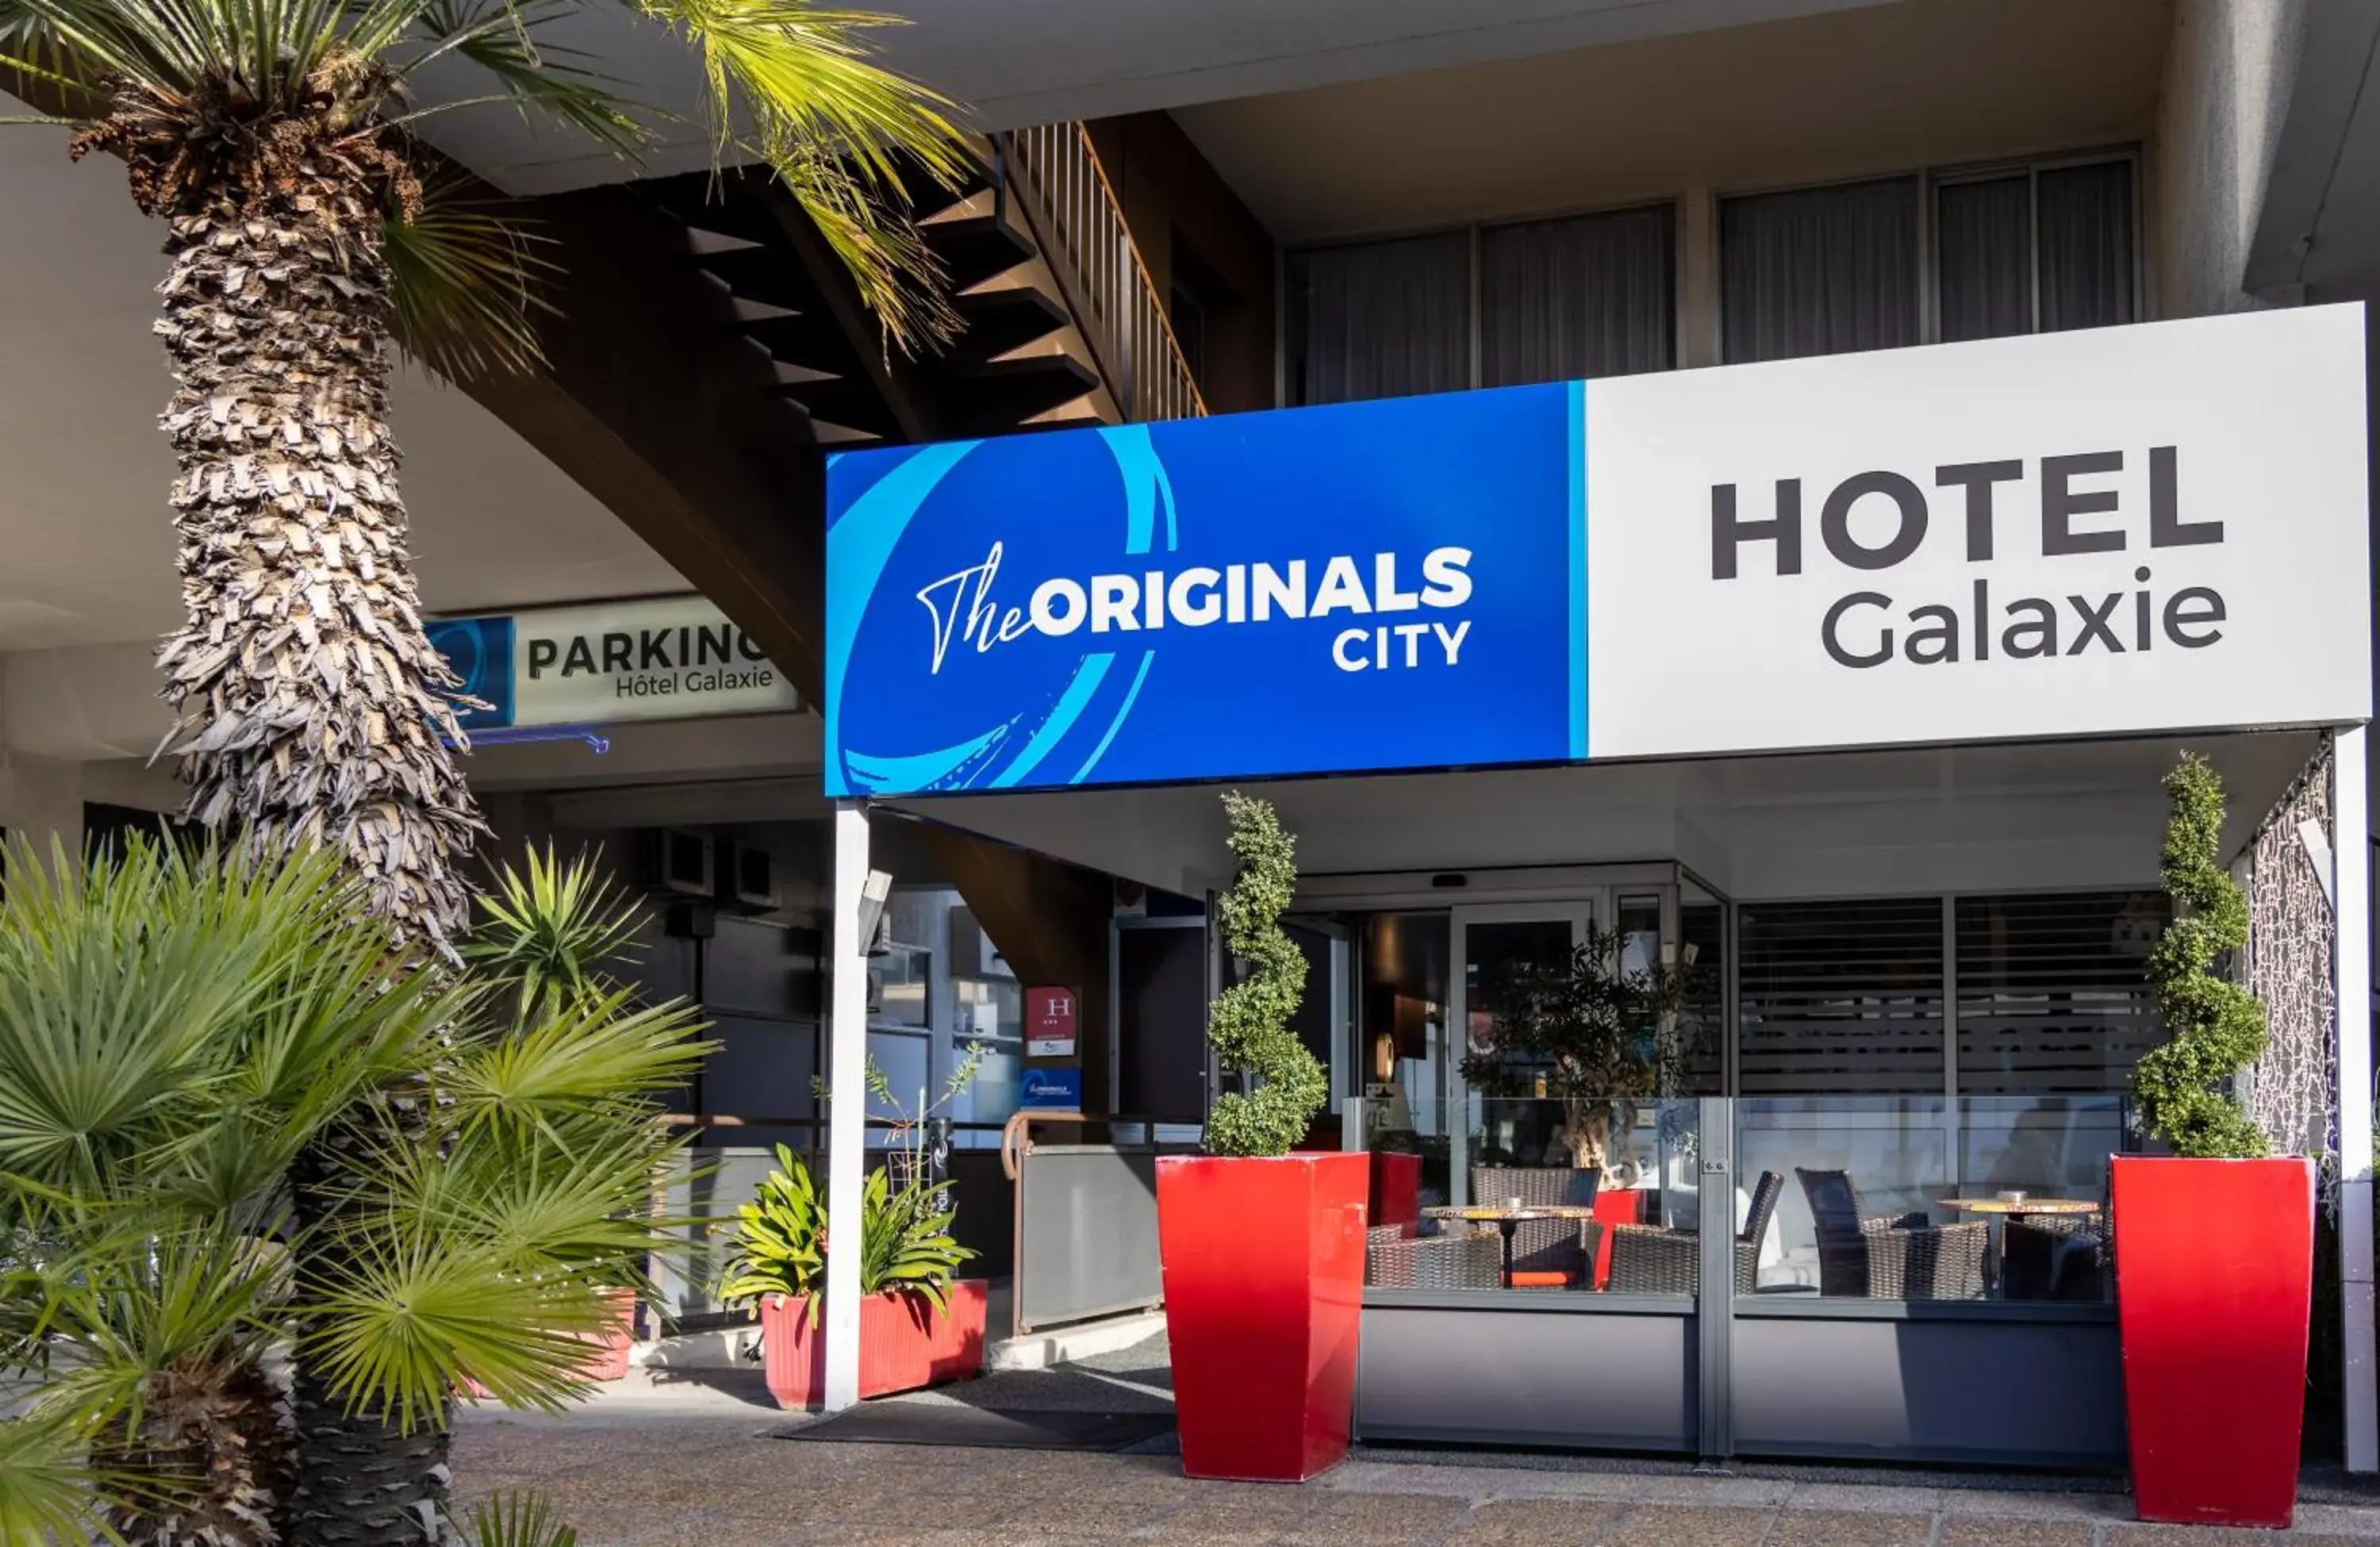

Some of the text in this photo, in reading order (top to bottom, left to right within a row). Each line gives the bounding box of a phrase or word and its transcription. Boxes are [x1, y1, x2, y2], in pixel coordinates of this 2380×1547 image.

[1711, 445, 2225, 580] HOTEL
[915, 540, 1473, 675] The ORIGINALS
[1821, 566, 2226, 669] Galaxie
[616, 666, 774, 698] Hôtel Galaxie
[1332, 621, 1472, 672] CITY
[1046, 998, 1072, 1016] H
